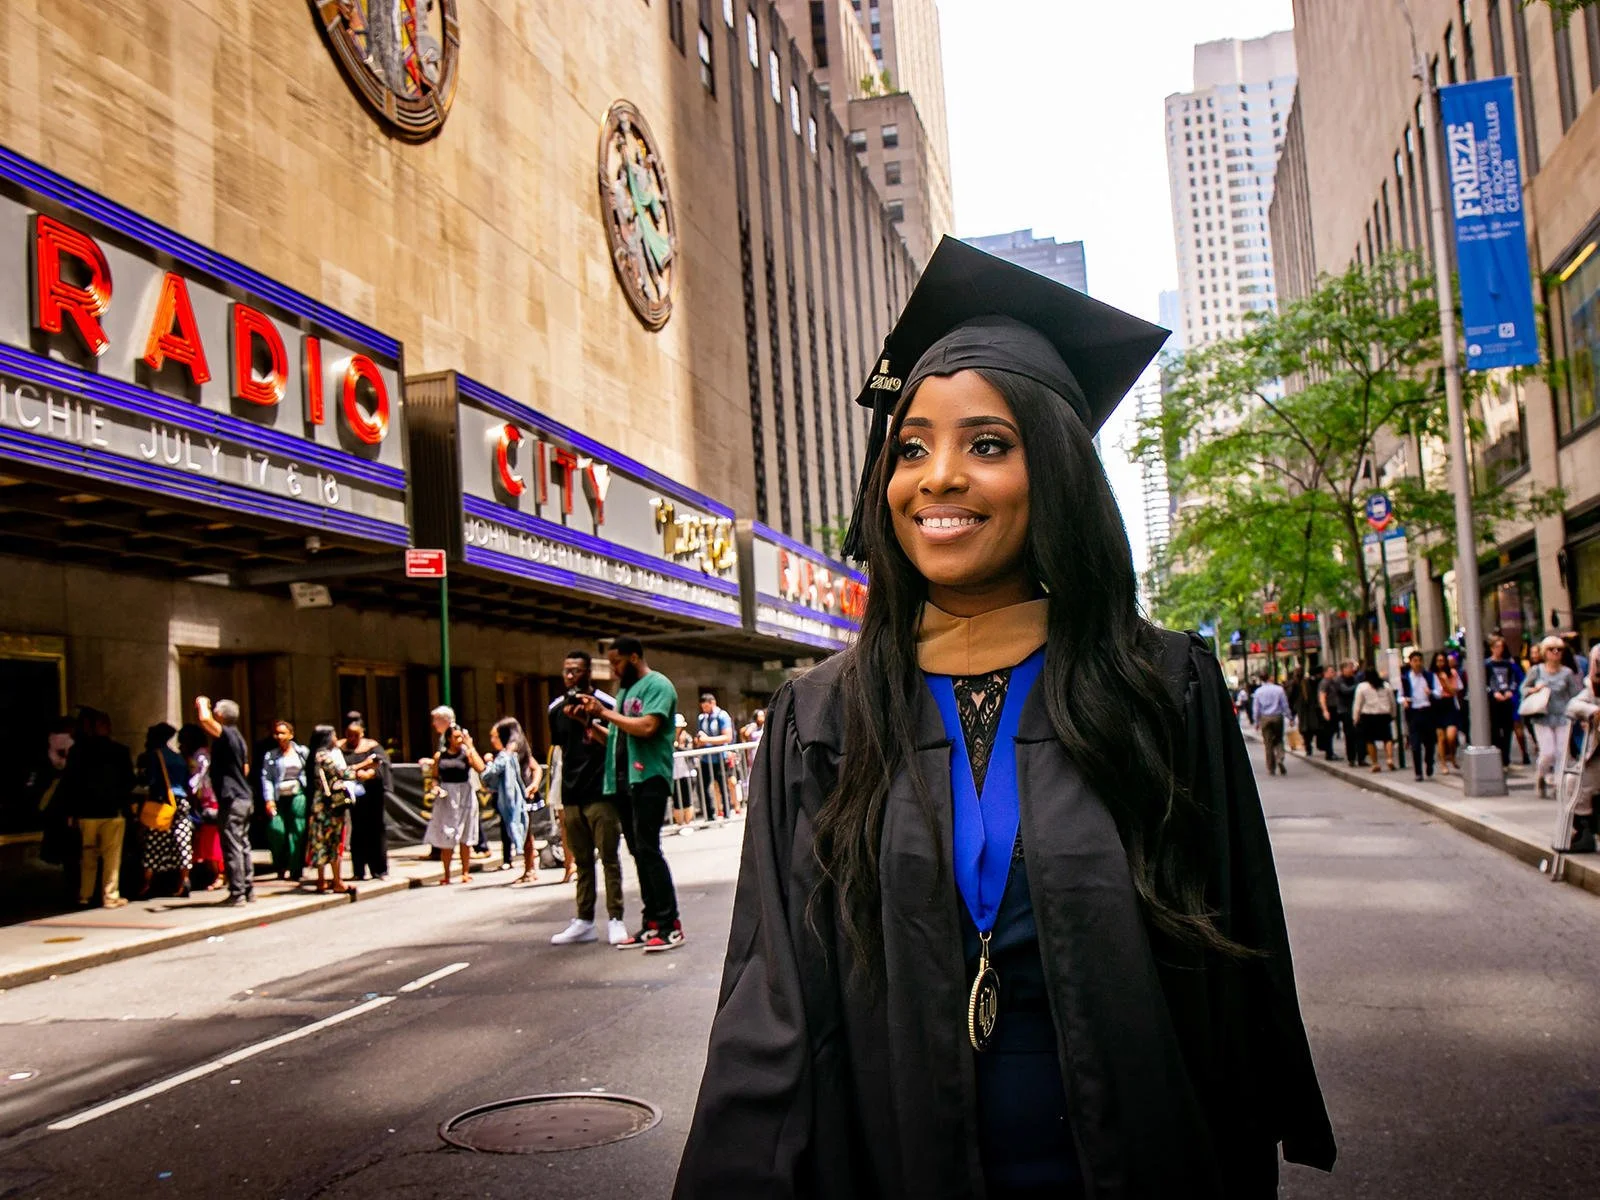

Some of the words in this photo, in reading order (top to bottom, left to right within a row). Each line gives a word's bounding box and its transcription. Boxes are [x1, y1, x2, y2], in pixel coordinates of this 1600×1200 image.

[1446, 122, 1483, 219] FRIEZE
[1476, 140, 1495, 216] SCULPTURE
[1485, 101, 1506, 196] ROCKEFELLER
[1503, 158, 1521, 213] CENTER
[30, 214, 390, 445] RADIO
[140, 422, 221, 475] JULY
[243, 450, 269, 486] 17
[316, 471, 340, 505] 18
[488, 422, 611, 525] CITY
[464, 519, 510, 550] JOHN
